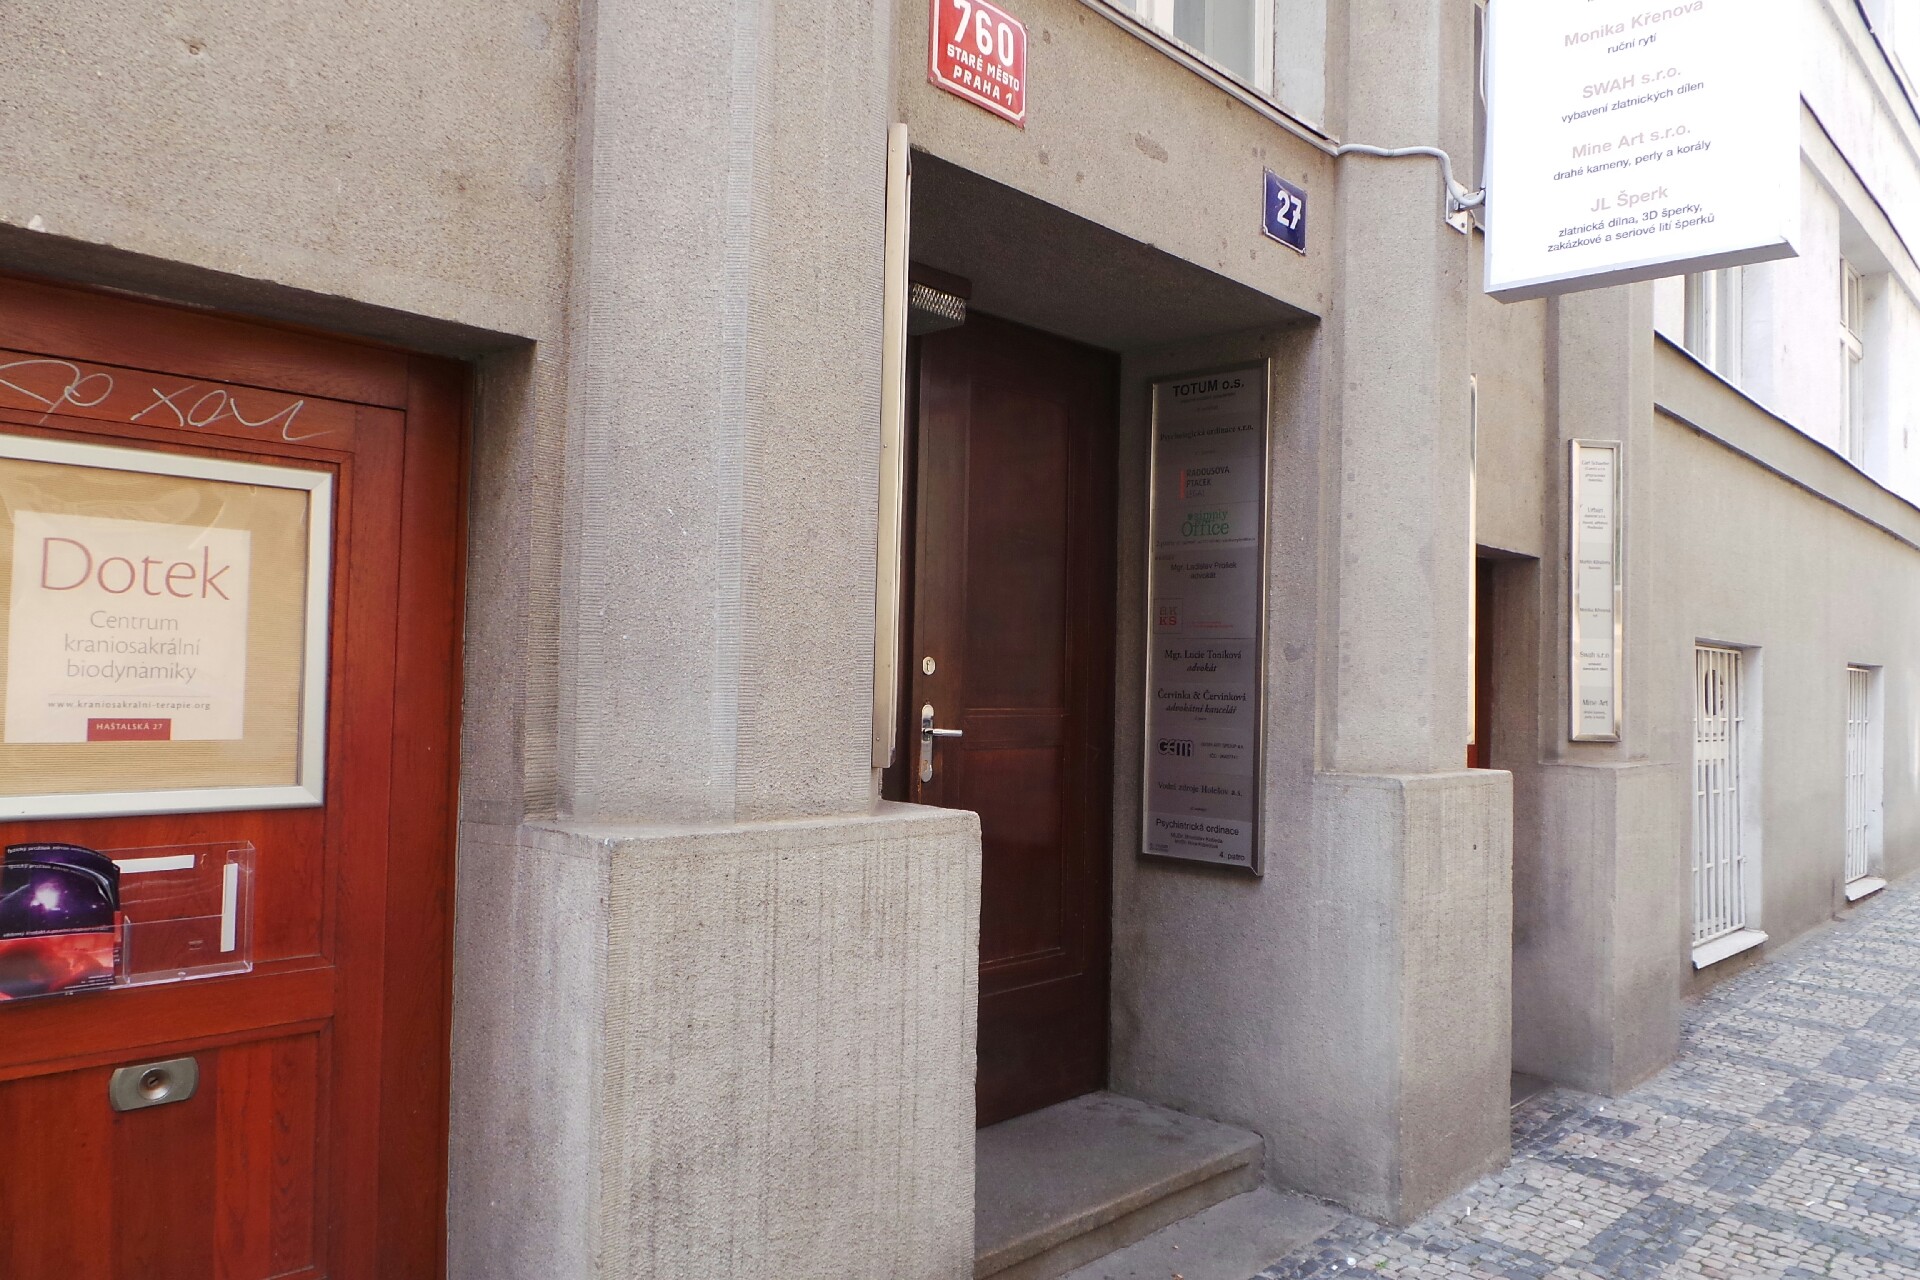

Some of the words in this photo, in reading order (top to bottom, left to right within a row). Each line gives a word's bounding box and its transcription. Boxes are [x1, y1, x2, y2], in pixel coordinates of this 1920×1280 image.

[953, 0, 1014, 67] 760
[1564, 21, 1625, 47] Monika
[1607, 38, 1636, 54] ruční
[1638, 32, 1657, 47] rytí
[947, 43, 983, 71] STARÉ
[986, 64, 1020, 92] MĚSTO
[953, 65, 1001, 99] PRAHA
[1005, 92, 1013, 106] 1
[1582, 74, 1635, 99] SWAH
[1641, 65, 1681, 85] s.r.o.
[1561, 104, 1609, 124] vybavení
[1611, 88, 1674, 111] zlatnických
[1677, 80, 1704, 96] dílen
[1572, 140, 1612, 160] Mine
[1617, 132, 1645, 150] Art
[1650, 123, 1691, 142] s.r.o.
[1553, 166, 1584, 181] drahé
[1586, 158, 1632, 175] kameny,
[1635, 150, 1663, 166] perly
[1666, 148, 1674, 157] a
[1677, 139, 1712, 156] korály
[1277, 190, 1302, 230] 27
[1590, 197, 1611, 213] JL
[1617, 185, 1669, 209] Šperk
[1547, 235, 1602, 253] zakázkové
[1604, 234, 1612, 243] a
[1615, 224, 1656, 241] seriové
[1659, 219, 1673, 232] lití
[1675, 213, 1715, 230] šperků
[1558, 219, 1605, 238] zlatnická
[1608, 214, 1639, 229] dílna,
[1642, 210, 1658, 222] 3D
[1661, 202, 1703, 220] šperky,
[1173, 379, 1218, 397] TOTUM
[1222, 378, 1245, 390] o.s.
[1181, 520, 1230, 537] Office
[39, 537, 231, 601] Dotek
[90, 610, 179, 632] Centrum
[64, 634, 201, 657] kraniosakrální
[67, 658, 198, 684] biodynamiky
[1187, 662, 1217, 673] advokát
[1157, 687, 1191, 699] Červinka
[1193, 691, 1201, 700] &
[1203, 689, 1247, 702] Červinková
[96, 721, 150, 731] HAŠTALSKÁ
[153, 723, 163, 731] 27
[1158, 782, 1177, 791] Vodní
[1178, 784, 1199, 794] zdroje
[1201, 785, 1228, 796] Holešov
[1156, 818, 1204, 831] Psychiatrická
[1206, 825, 1239, 836] ordinace
[1228, 853, 1246, 861] patro
